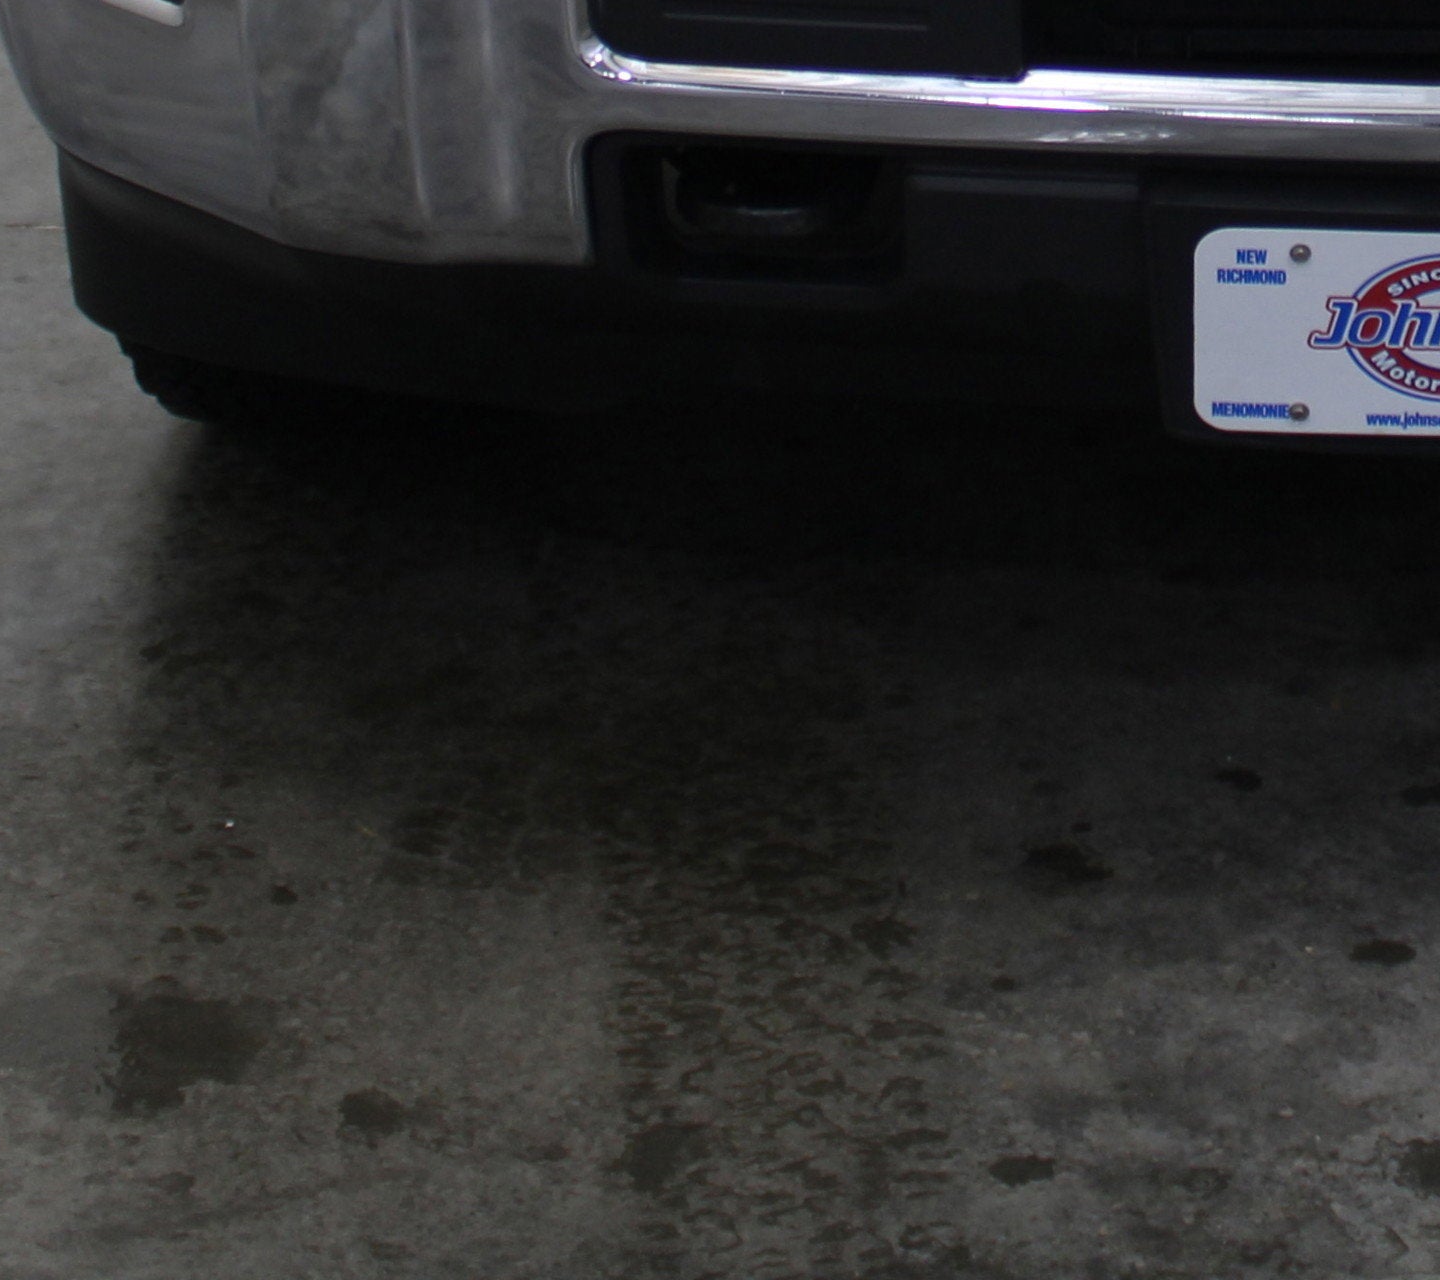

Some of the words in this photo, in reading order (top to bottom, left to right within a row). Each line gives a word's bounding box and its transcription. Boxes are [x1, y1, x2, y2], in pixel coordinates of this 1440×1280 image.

[1236, 249, 1267, 265] NEW
[1217, 268, 1287, 285] RICHMOND
[1211, 402, 1290, 419] MENOMONIE
